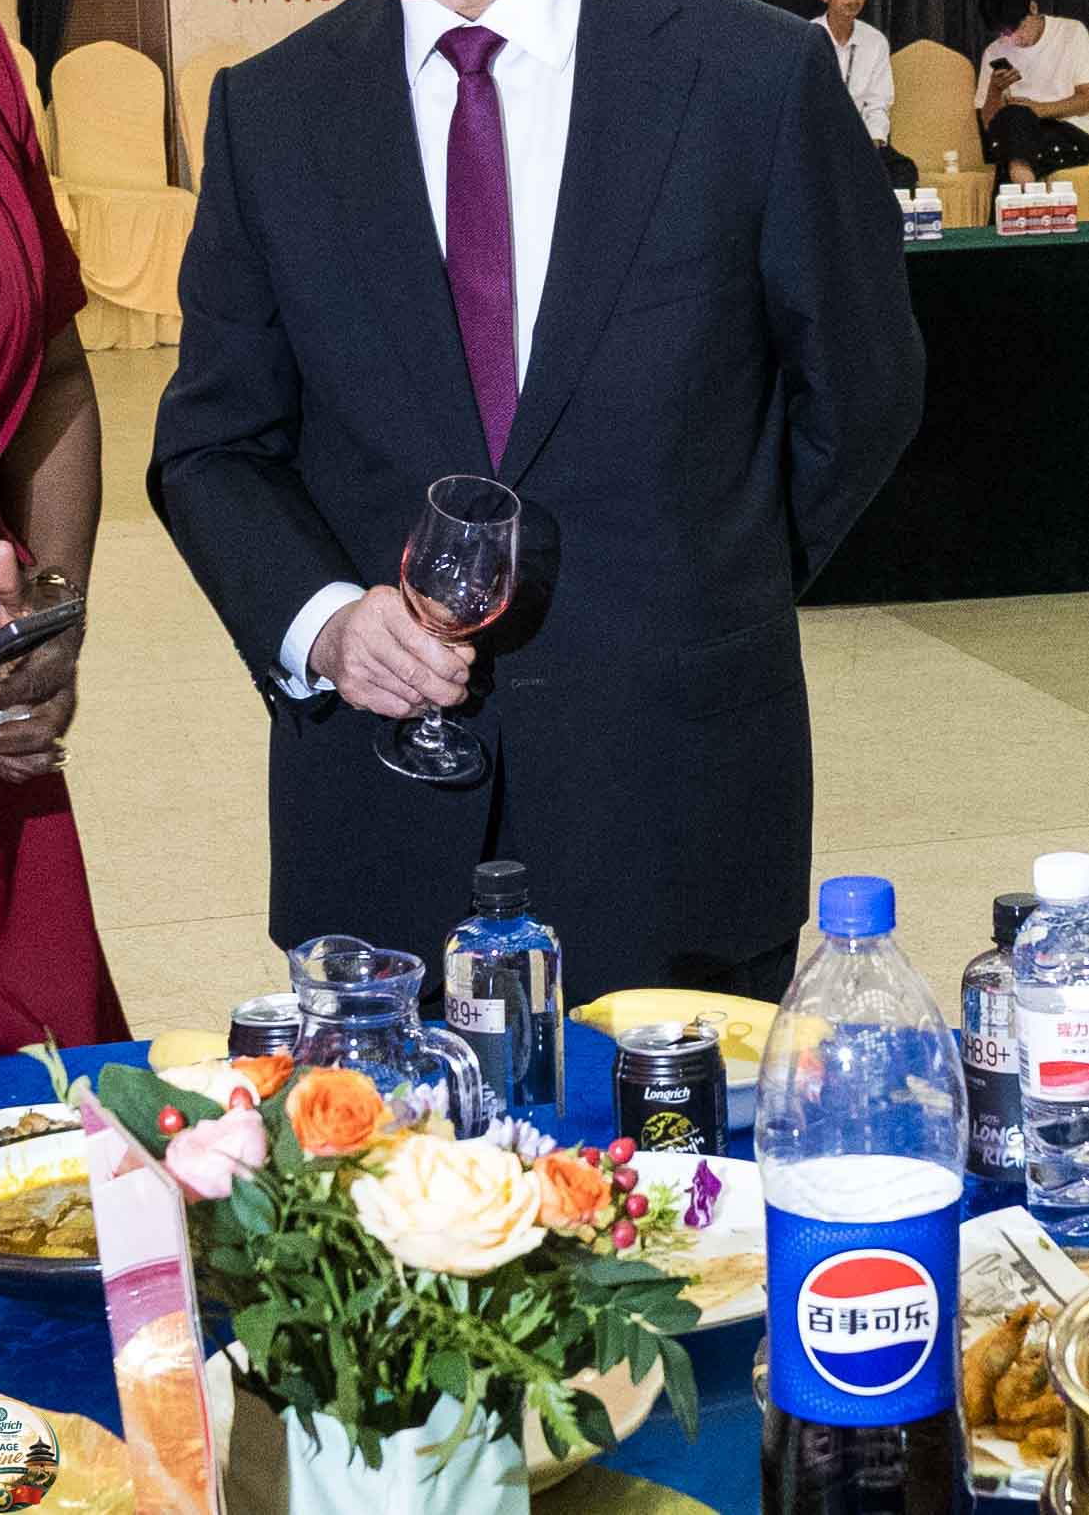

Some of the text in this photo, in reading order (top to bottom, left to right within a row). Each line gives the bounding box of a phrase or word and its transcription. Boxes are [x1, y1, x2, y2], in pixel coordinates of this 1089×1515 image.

[643, 1086, 691, 1103] Longrich
[807, 1300, 930, 1335] 百事可乐
